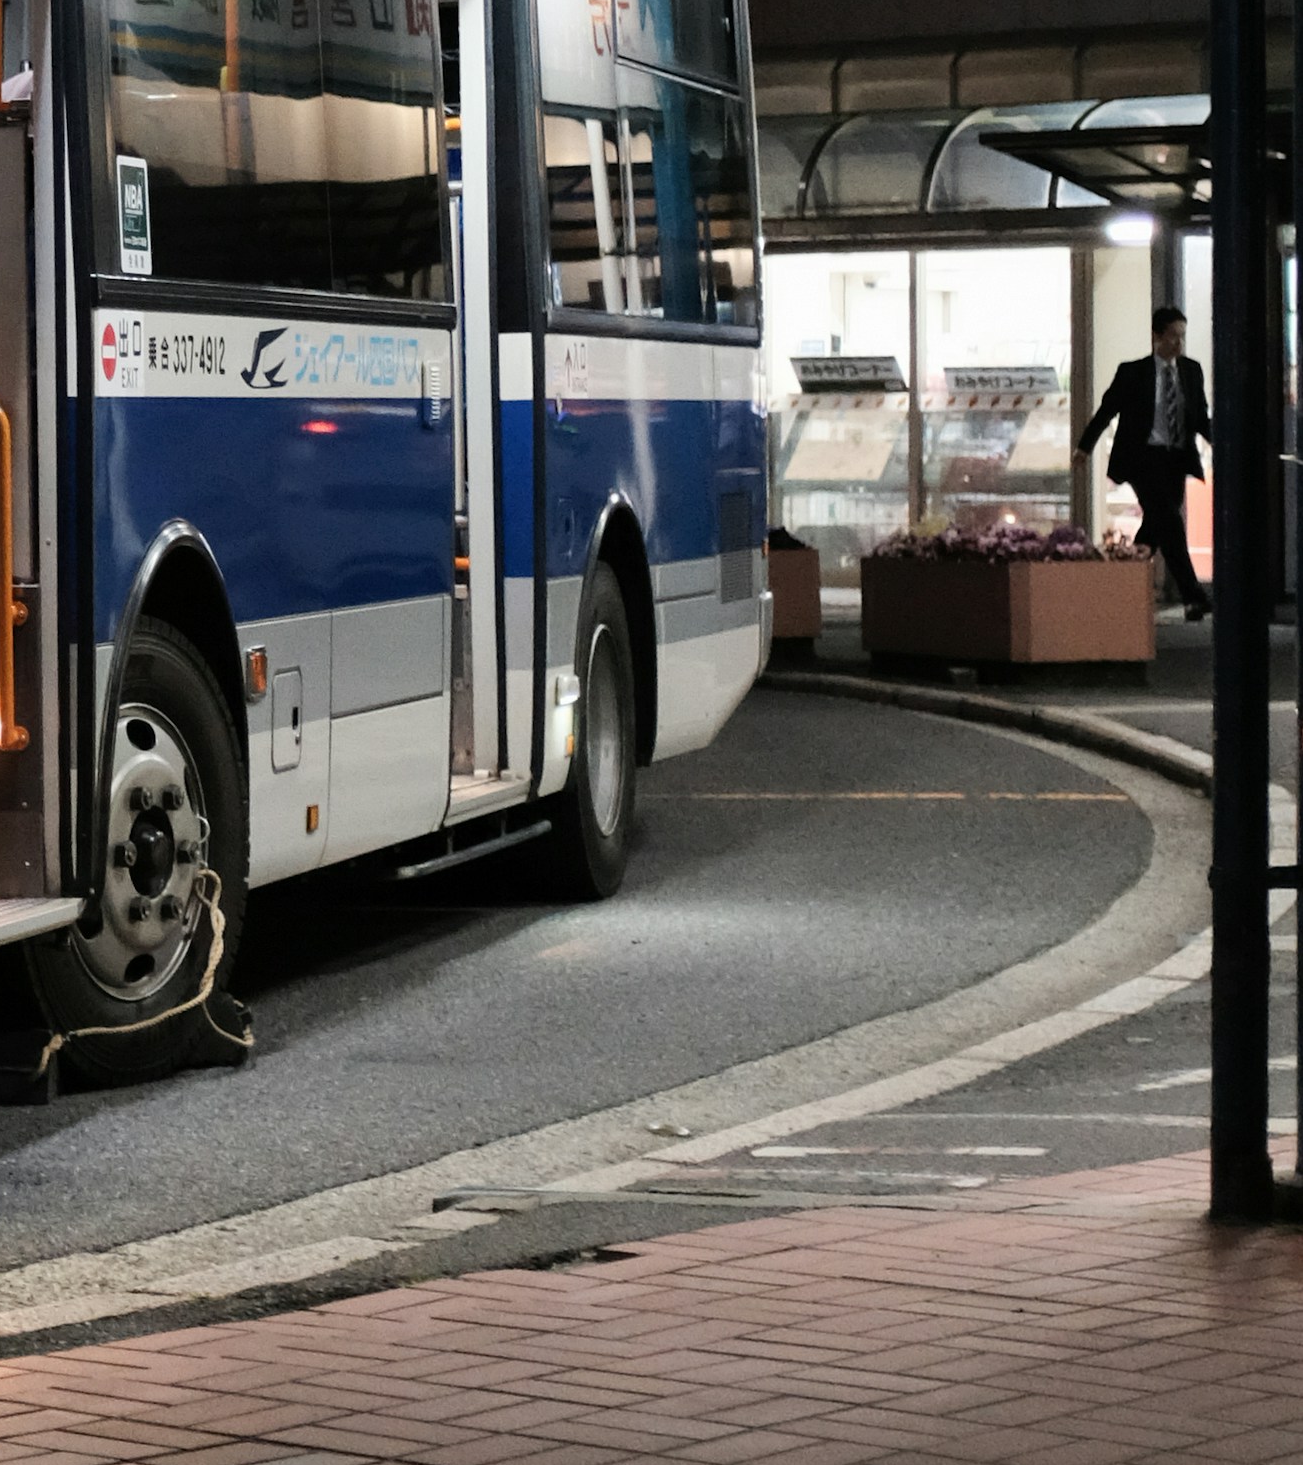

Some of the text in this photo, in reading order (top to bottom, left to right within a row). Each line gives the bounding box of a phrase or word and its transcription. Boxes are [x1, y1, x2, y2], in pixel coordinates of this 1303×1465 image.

[124, 183, 144, 211] NBA
[118, 318, 142, 357] 出口
[121, 367, 139, 389] EXIT
